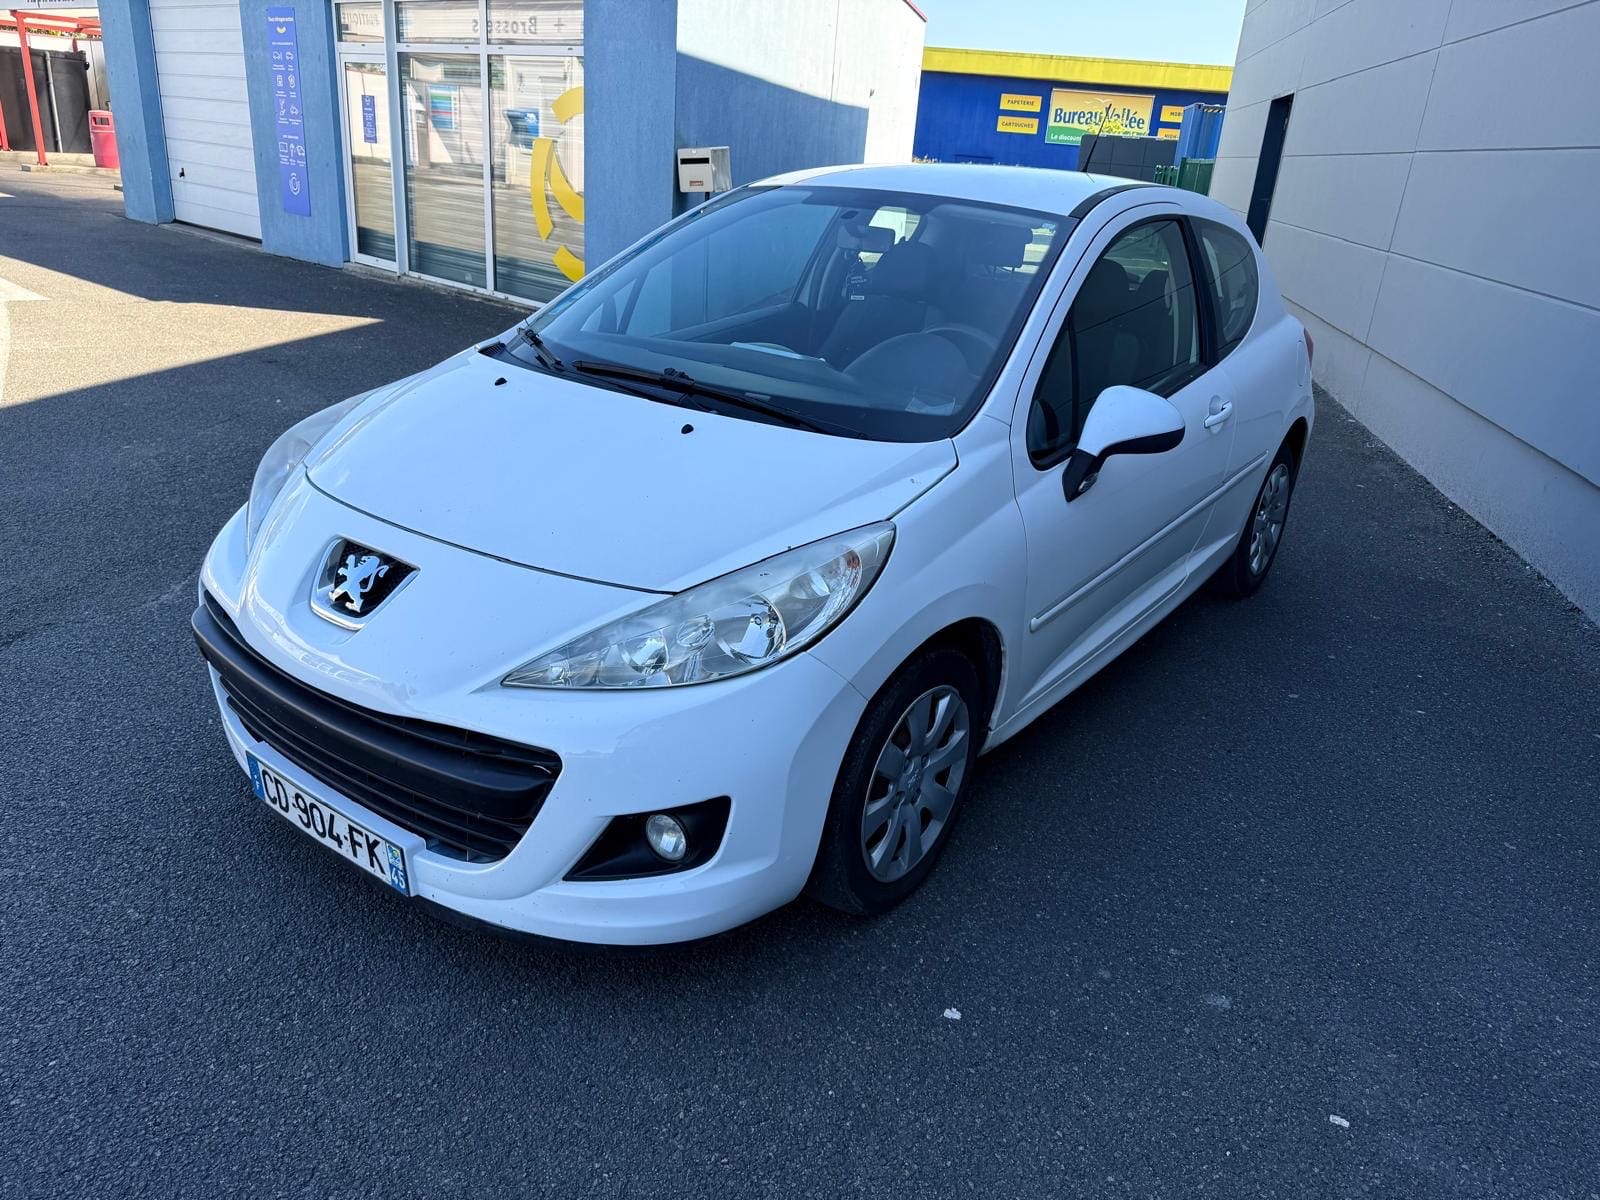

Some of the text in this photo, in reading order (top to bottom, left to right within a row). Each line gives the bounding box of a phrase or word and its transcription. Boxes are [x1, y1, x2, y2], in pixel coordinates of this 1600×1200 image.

[1001, 121, 1034, 129] CARTOUCHES
[1053, 107, 1103, 126] Bureau
[262, 769, 386, 876] CD-904-FK
[391, 866, 406, 889] 45
